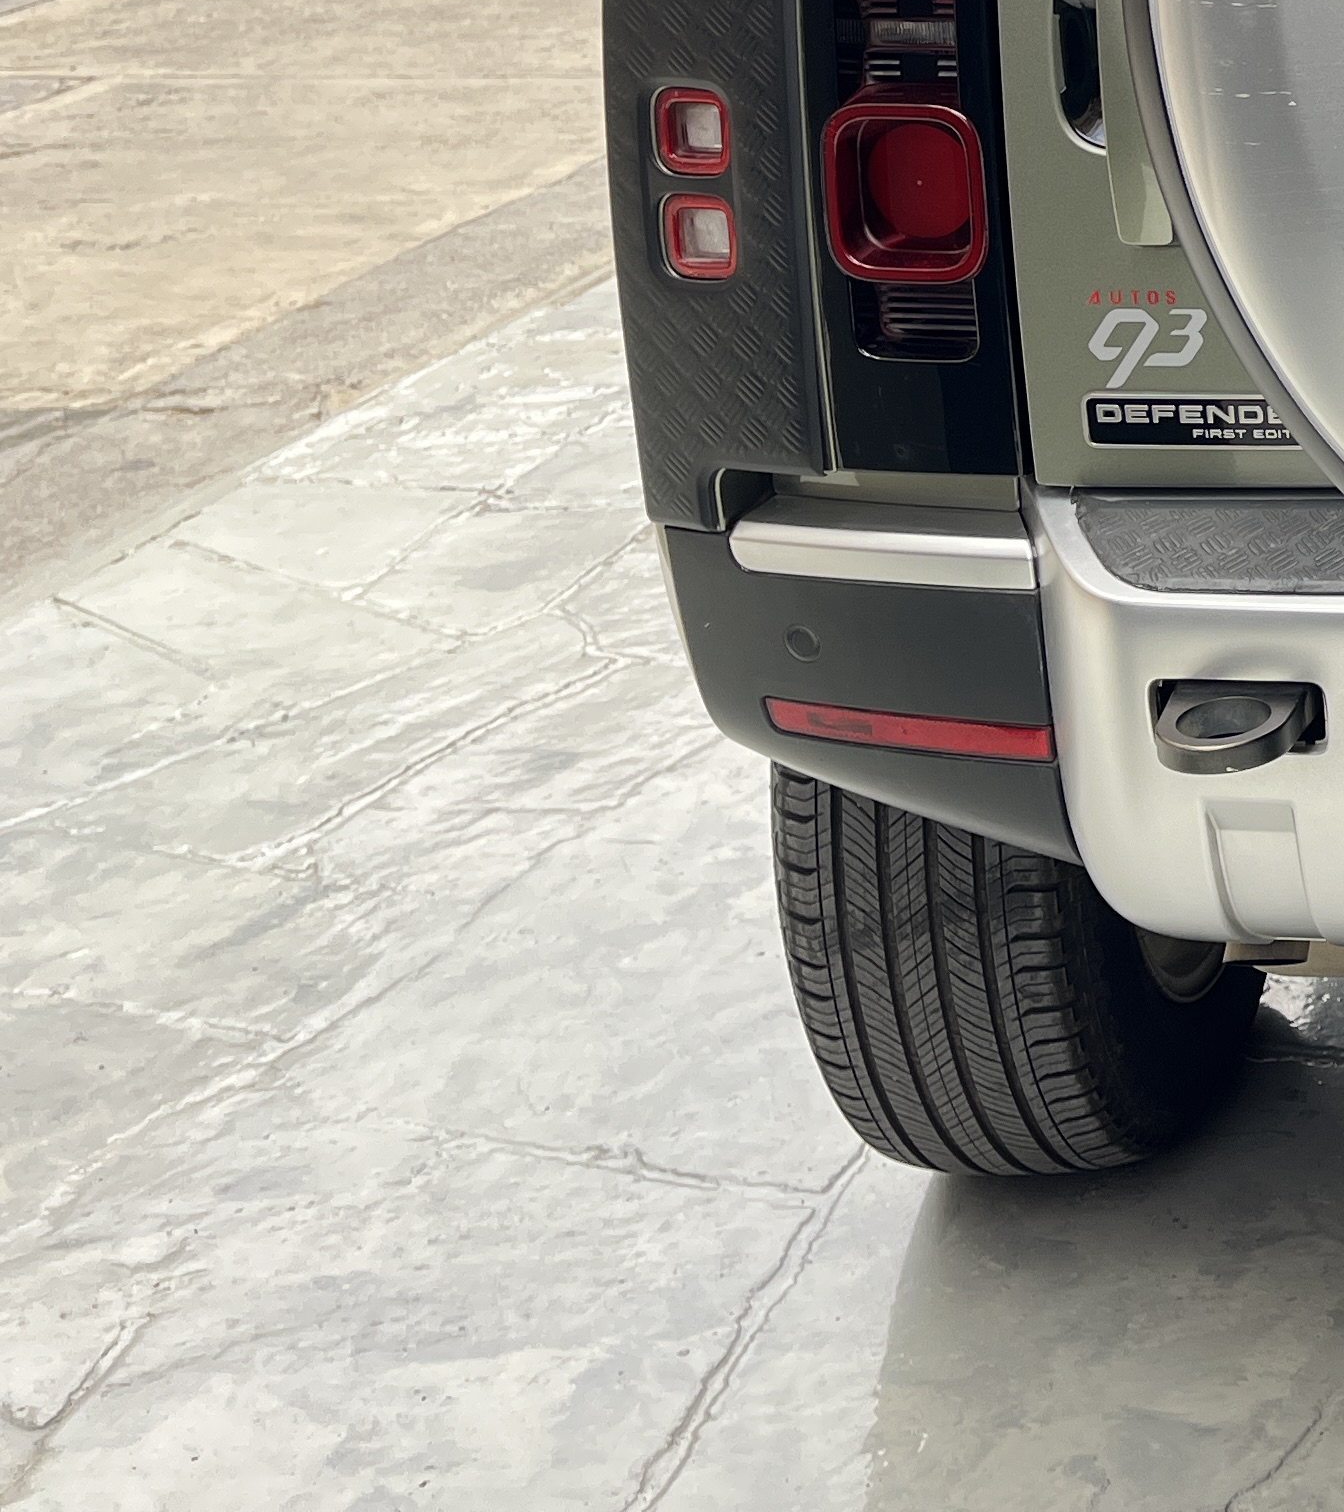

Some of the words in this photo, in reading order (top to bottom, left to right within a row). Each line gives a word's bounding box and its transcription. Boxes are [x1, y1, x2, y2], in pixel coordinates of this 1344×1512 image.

[1087, 289, 1177, 306] AUTOS
[1088, 308, 1208, 389] 93
[1192, 428, 1247, 440] FIRST
